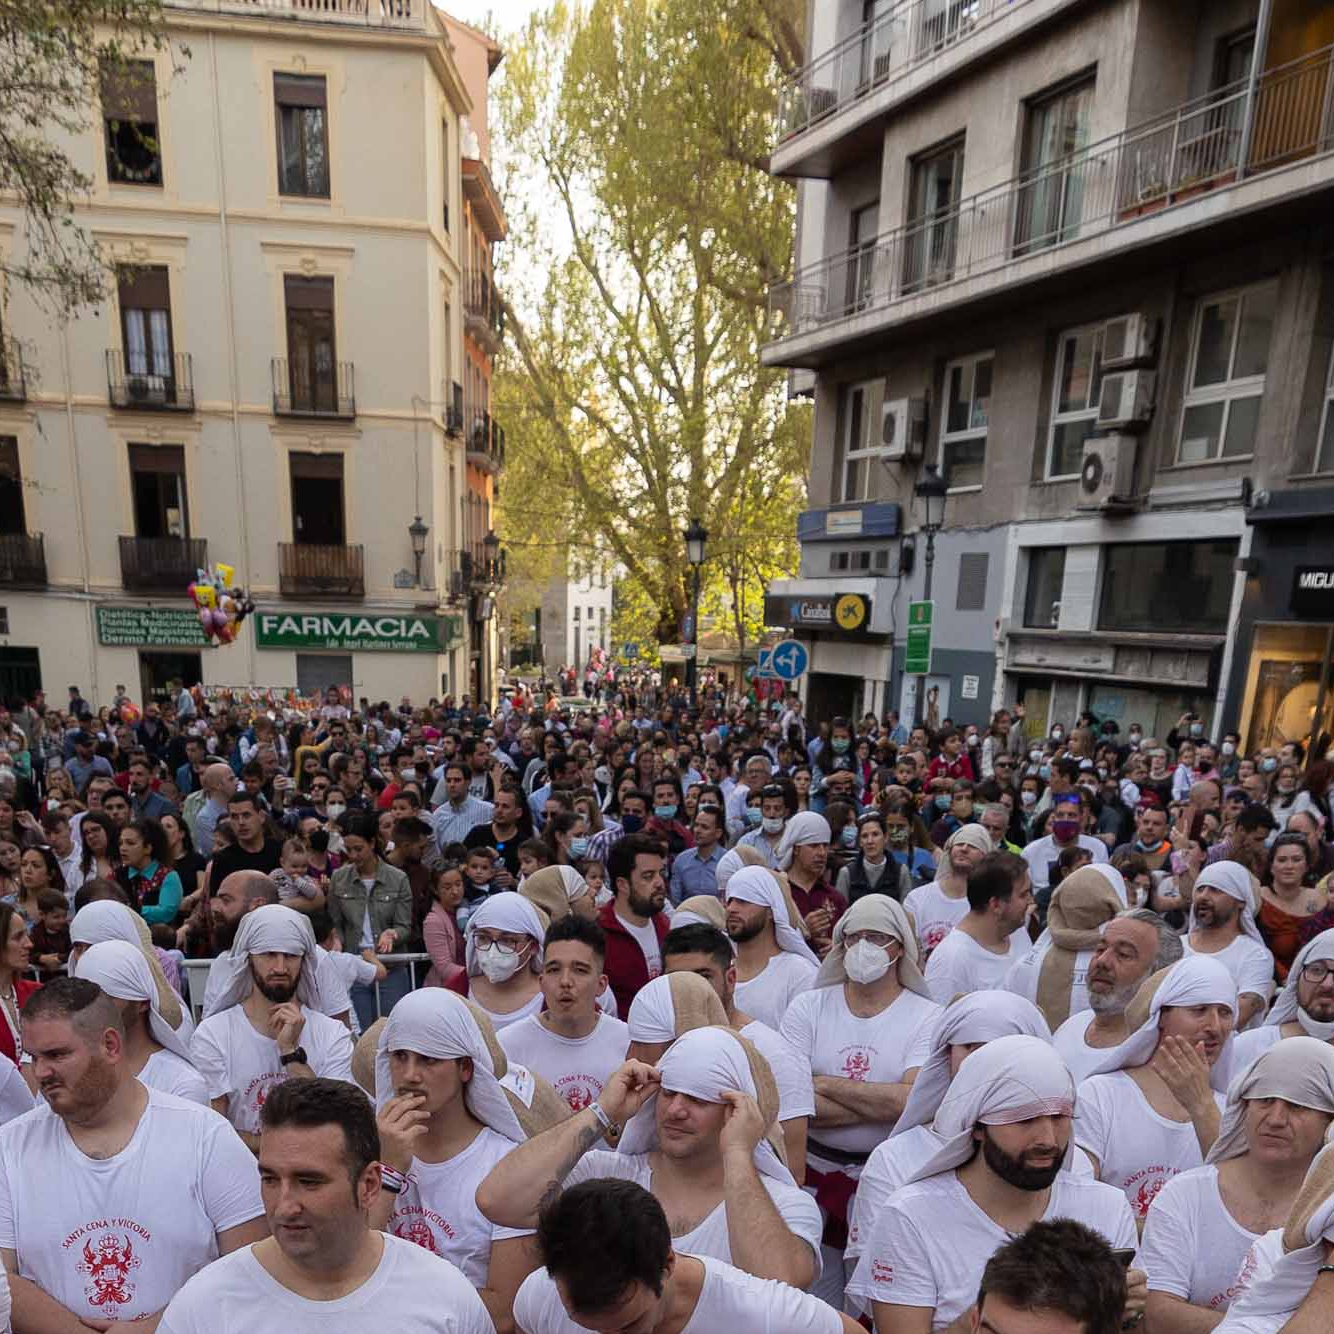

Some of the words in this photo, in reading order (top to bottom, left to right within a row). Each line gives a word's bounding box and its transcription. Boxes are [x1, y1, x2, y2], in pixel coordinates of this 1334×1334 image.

[261, 615, 431, 639] FARMACIA
[147, 635, 206, 646] Farmacia
[61, 1228, 87, 1250] SANTA
[85, 1219, 109, 1232] CENA
[111, 1219, 118, 1227] Y
[118, 1218, 152, 1243] VICTORIA
